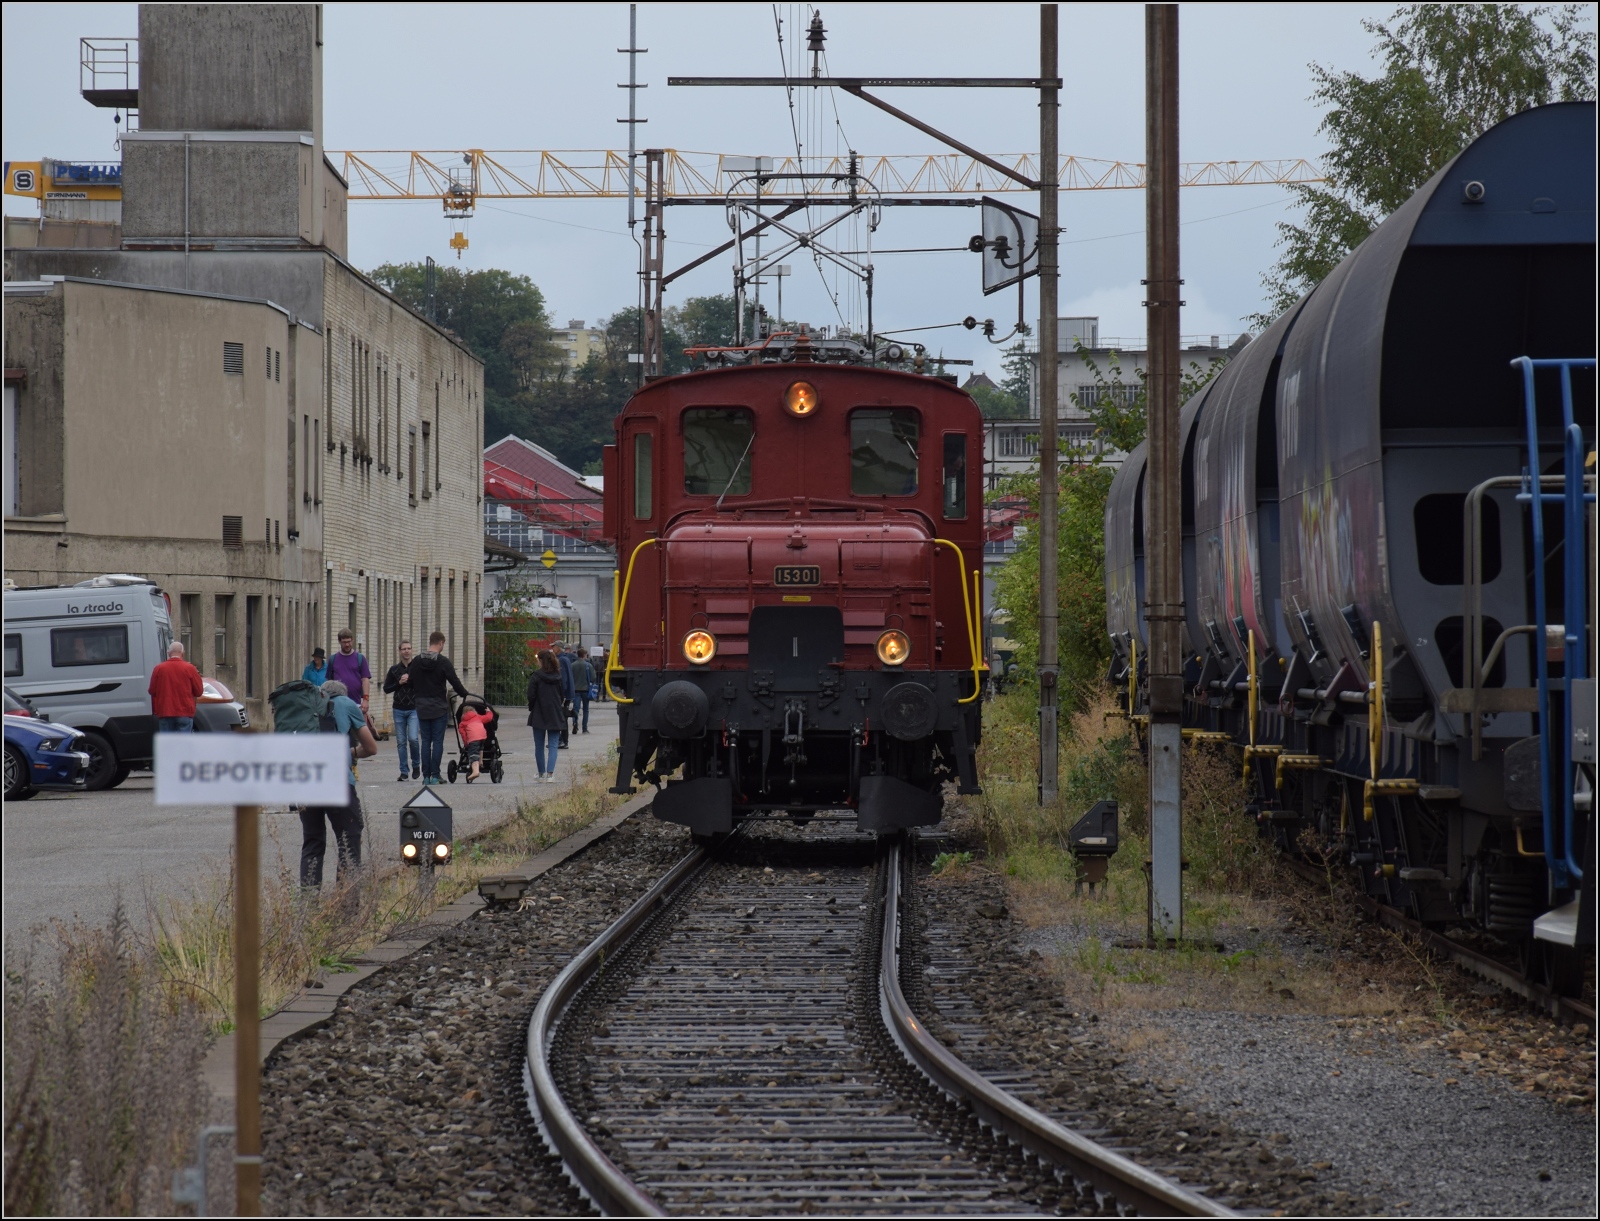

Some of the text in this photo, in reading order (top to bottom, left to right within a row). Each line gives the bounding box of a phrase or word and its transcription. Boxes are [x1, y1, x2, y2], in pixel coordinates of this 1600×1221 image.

[56, 165, 121, 179] POTAIN
[778, 569, 816, 583] 15301
[67, 601, 123, 614] la strada
[179, 762, 327, 783] DEPOTFEST
[413, 831, 435, 839] VG 671
